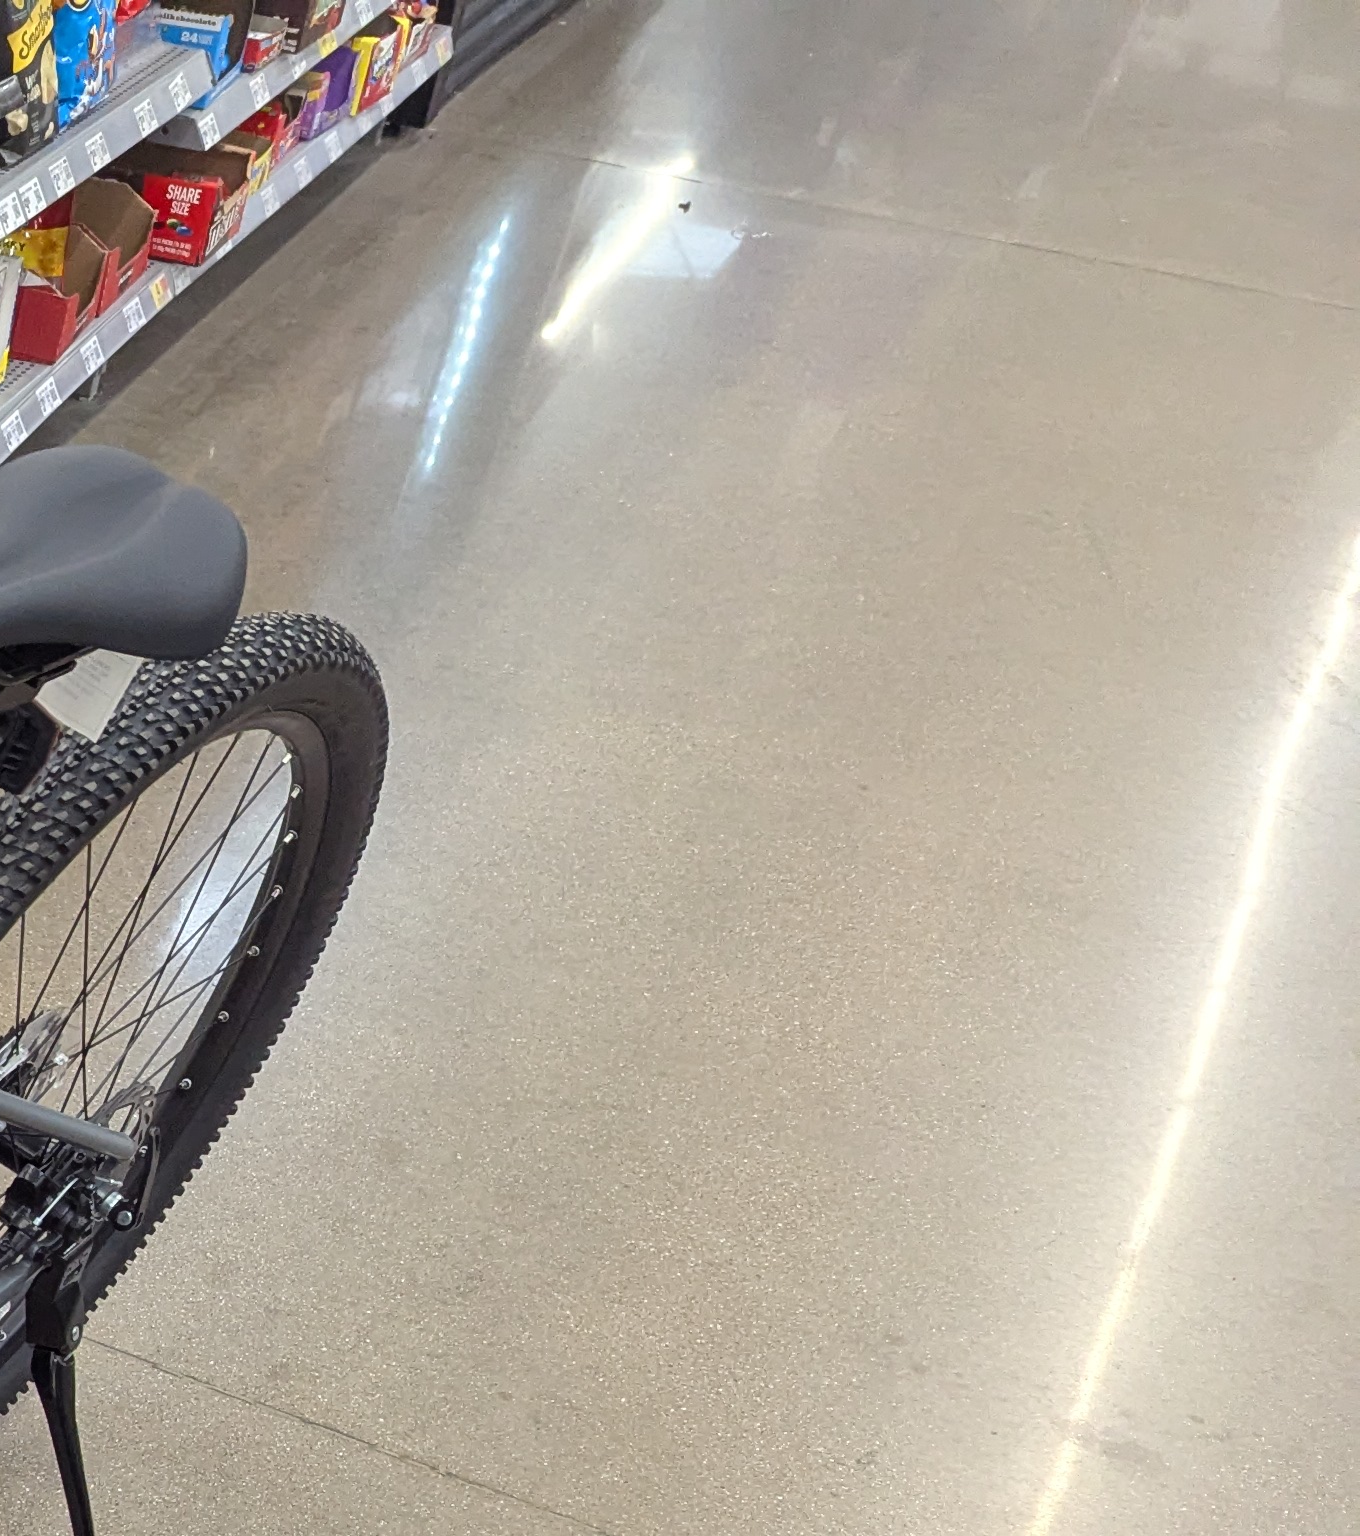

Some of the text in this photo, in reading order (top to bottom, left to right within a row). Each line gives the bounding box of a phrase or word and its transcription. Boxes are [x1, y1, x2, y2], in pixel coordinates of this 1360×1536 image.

[181, 31, 198, 43] 24
[166, 184, 202, 205] SHARE
[170, 201, 191, 216] SIZE
